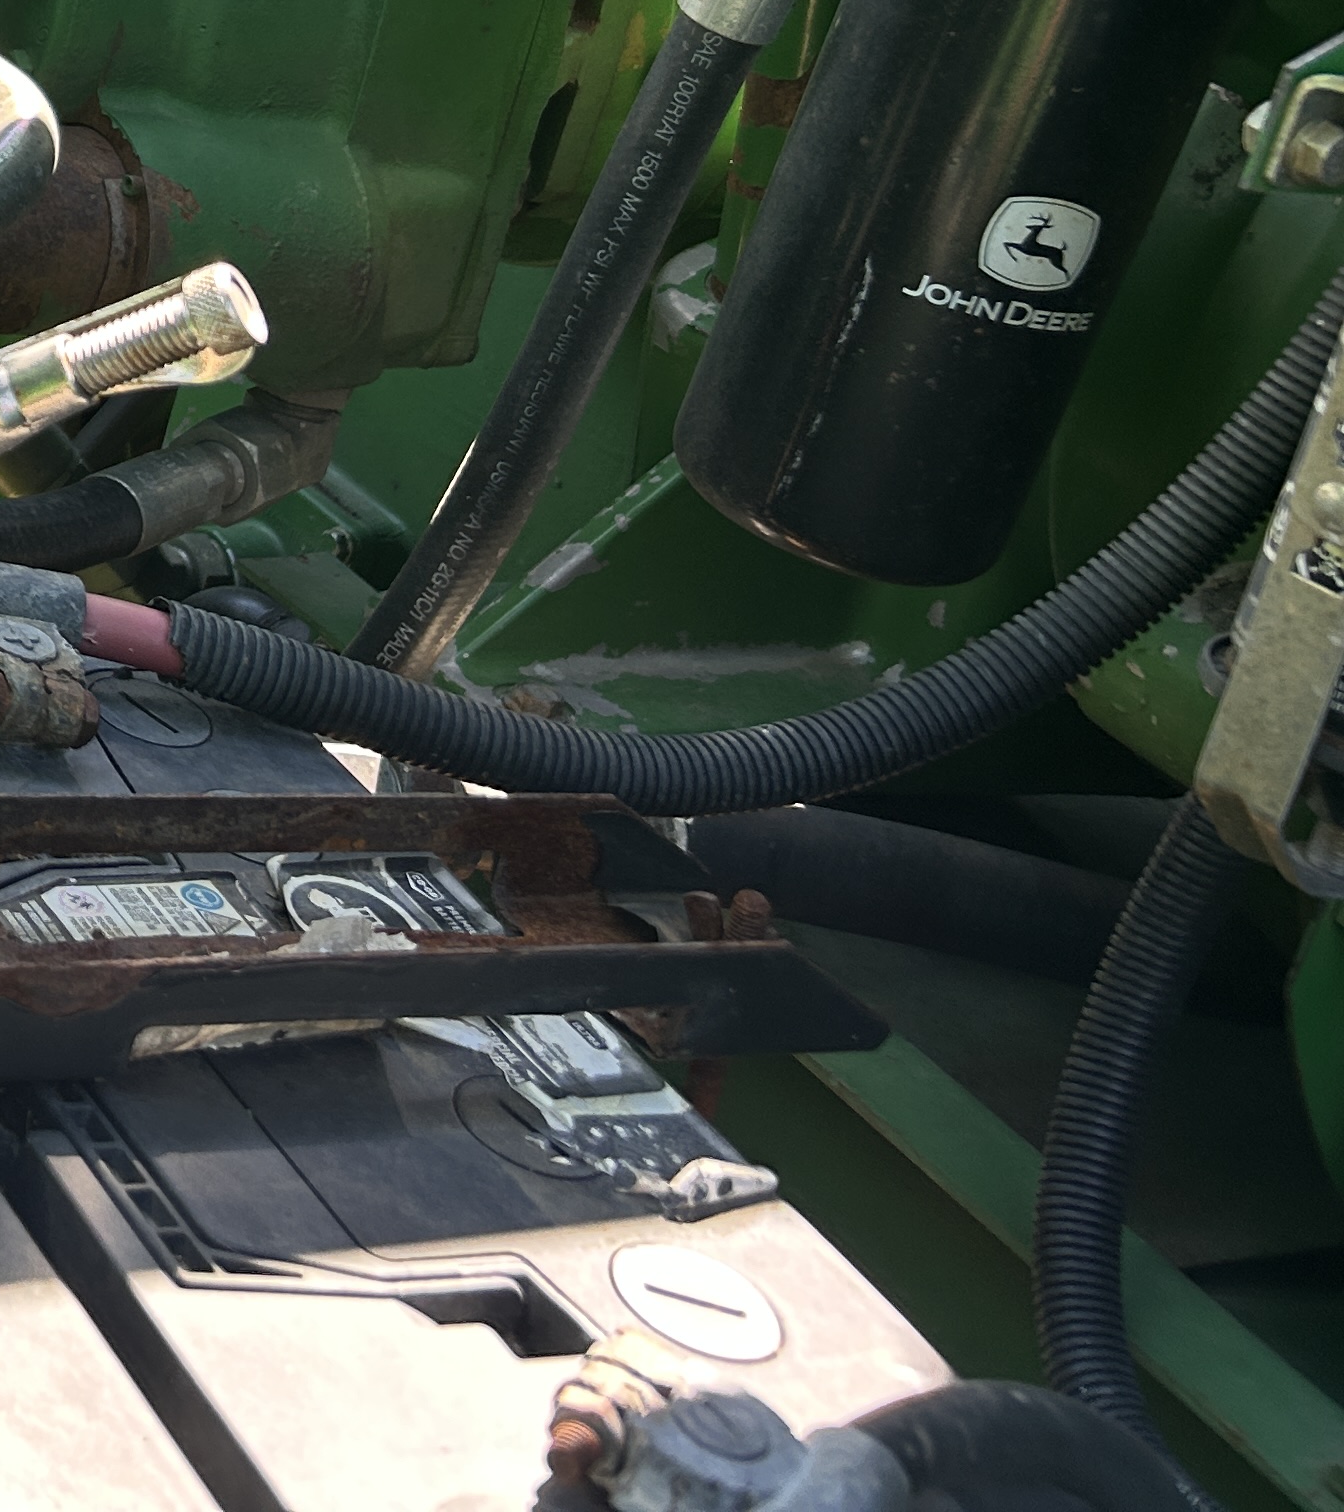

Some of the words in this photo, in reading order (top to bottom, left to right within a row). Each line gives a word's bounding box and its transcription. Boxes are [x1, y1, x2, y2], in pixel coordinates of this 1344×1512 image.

[691, 31, 723, 70] SAE
[631, 149, 663, 191] 1500
[609, 192, 643, 236] MAX
[901, 274, 1004, 322] JOHN
[1002, 300, 1095, 332] DEERE
[375, 622, 417, 669] MADE
